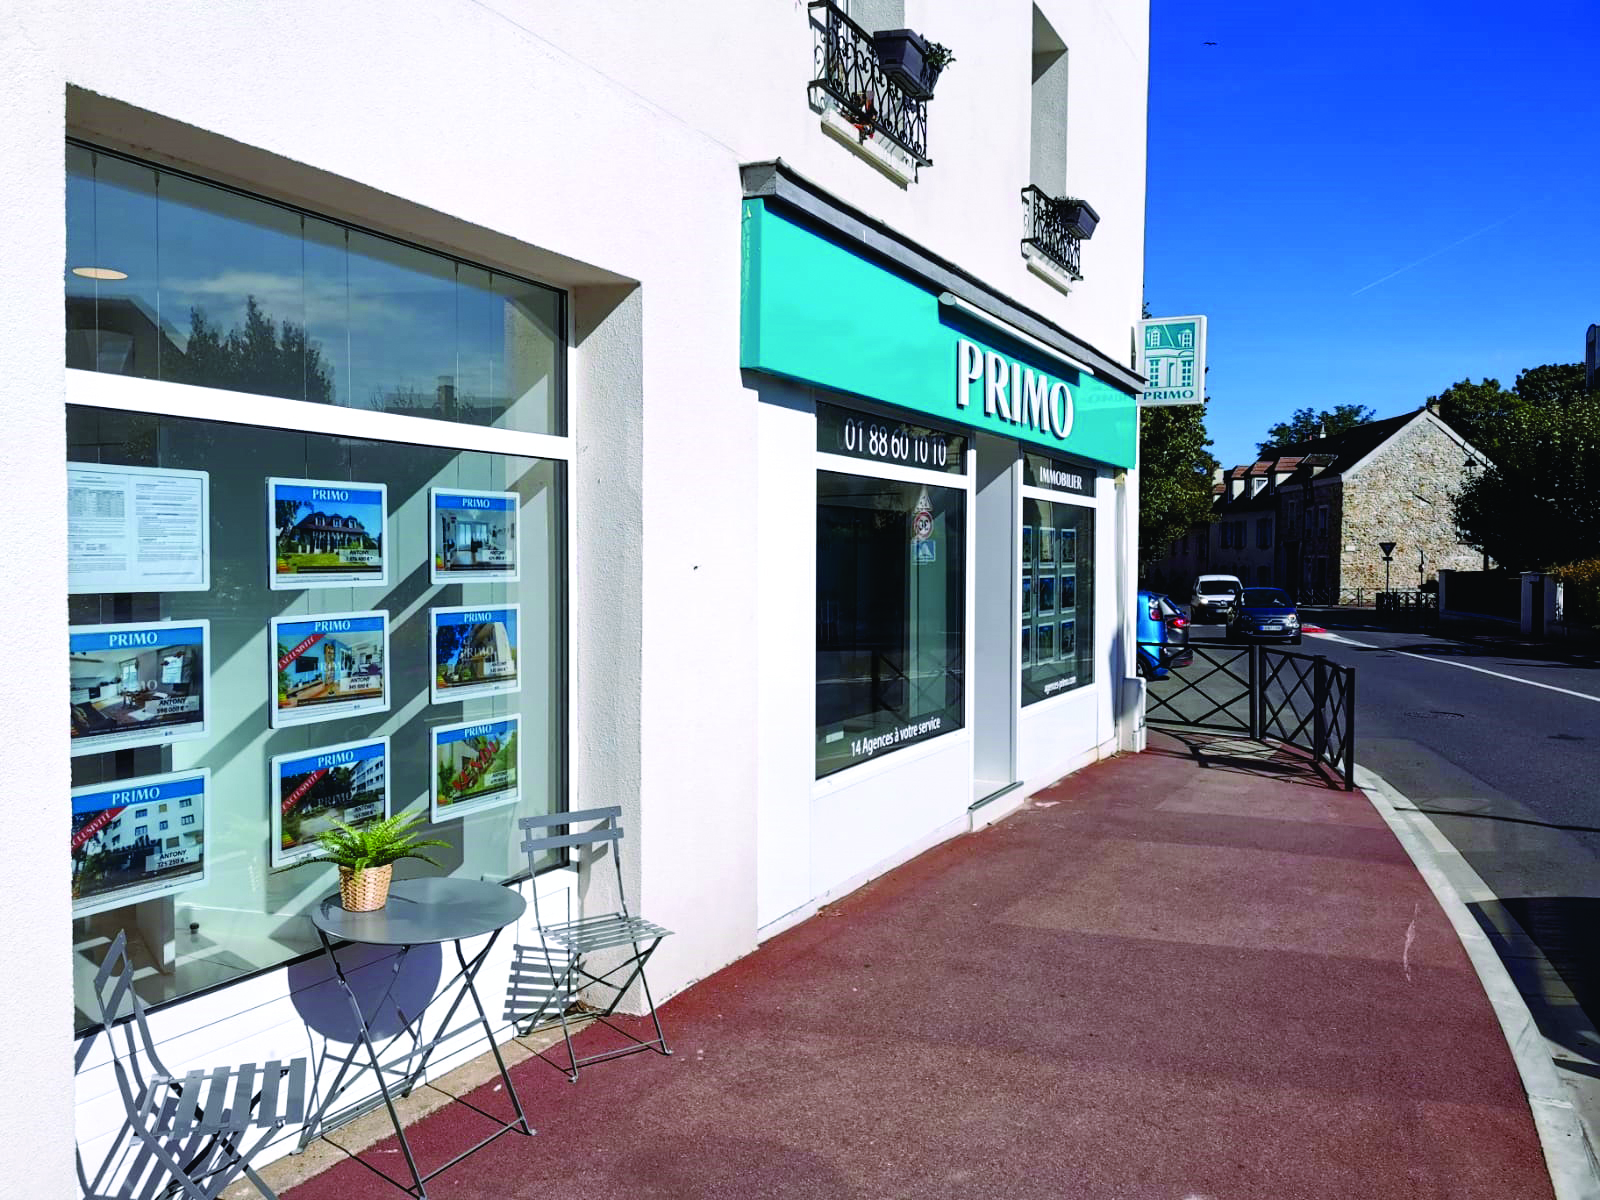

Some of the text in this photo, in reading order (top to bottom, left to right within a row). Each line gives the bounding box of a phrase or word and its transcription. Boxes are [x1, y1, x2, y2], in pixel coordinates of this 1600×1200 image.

[958, 338, 1074, 439] PRIMO
[1143, 390, 1194, 401] PRIMO
[845, 418, 946, 467] 01 88 60 10 10
[1039, 466, 1082, 490] IMMOBILIER
[312, 488, 349, 501] PRIMO
[462, 497, 490, 508] PRIMO
[464, 612, 492, 623] PRIMO
[314, 620, 351, 632] PRIMO
[109, 631, 158, 647] PRIMO
[464, 724, 493, 738] PRIMO
[851, 716, 941, 757] 14 Agences à votre service
[318, 750, 354, 768] PRIMO
[112, 786, 160, 805] PRIMO
[160, 849, 187, 860] ANTONY
